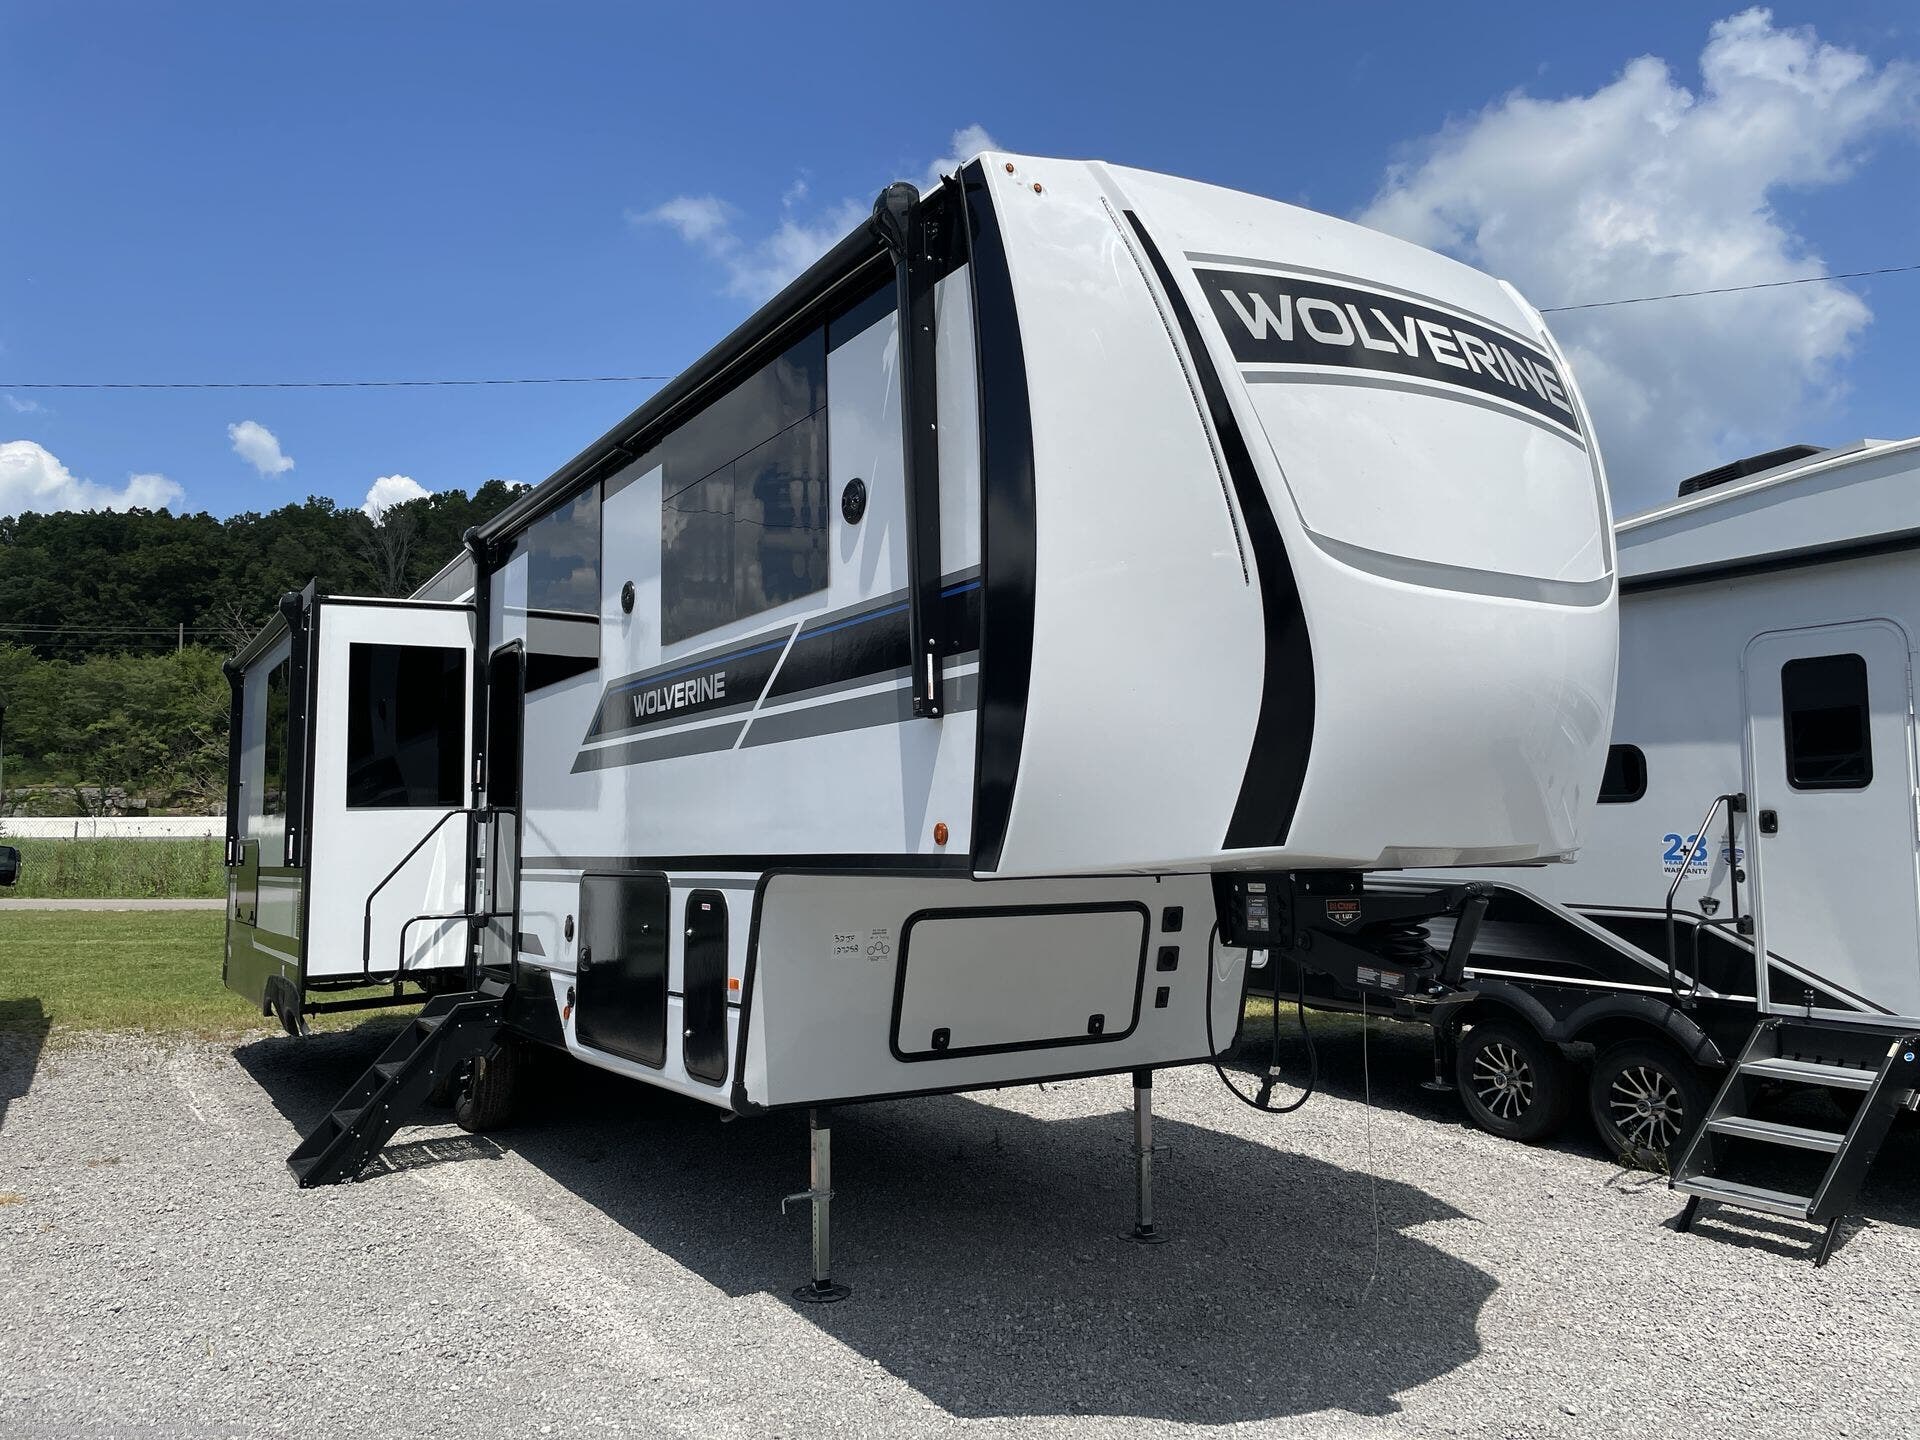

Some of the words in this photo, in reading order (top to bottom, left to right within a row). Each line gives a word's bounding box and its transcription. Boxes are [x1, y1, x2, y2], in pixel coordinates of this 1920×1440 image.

[1220, 289, 1572, 415] WOLVERINE
[633, 671, 726, 717] WOLVERINE
[1664, 867, 1708, 875] WARANTY
